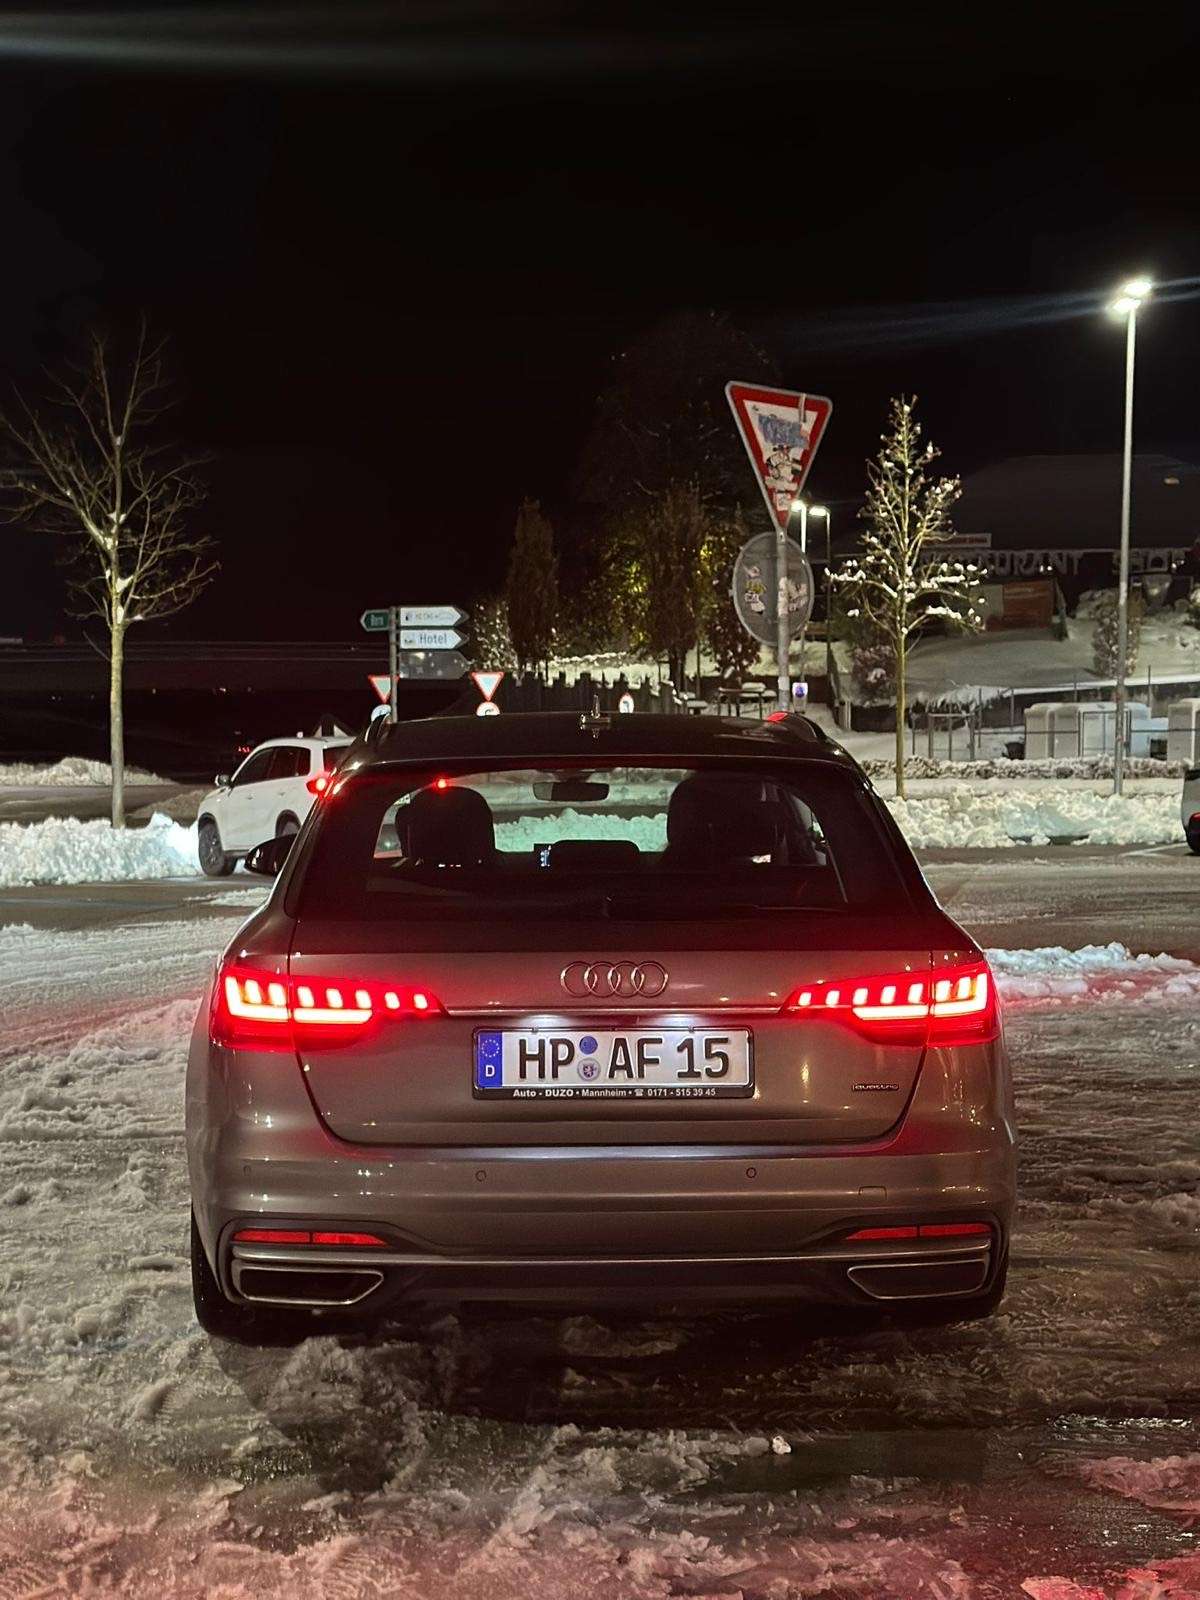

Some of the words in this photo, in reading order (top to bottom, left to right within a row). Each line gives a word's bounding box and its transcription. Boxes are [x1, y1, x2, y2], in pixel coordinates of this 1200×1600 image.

[419, 633, 447, 645] Hotel
[518, 1038, 575, 1079] HP
[608, 1037, 663, 1079] AF
[676, 1037, 730, 1078] 15
[485, 1064, 495, 1077] D
[513, 1089, 537, 1097] Auto
[545, 1089, 574, 1097] DUZO
[581, 1089, 627, 1097] Mannheim
[647, 1088, 667, 1097] 0171
